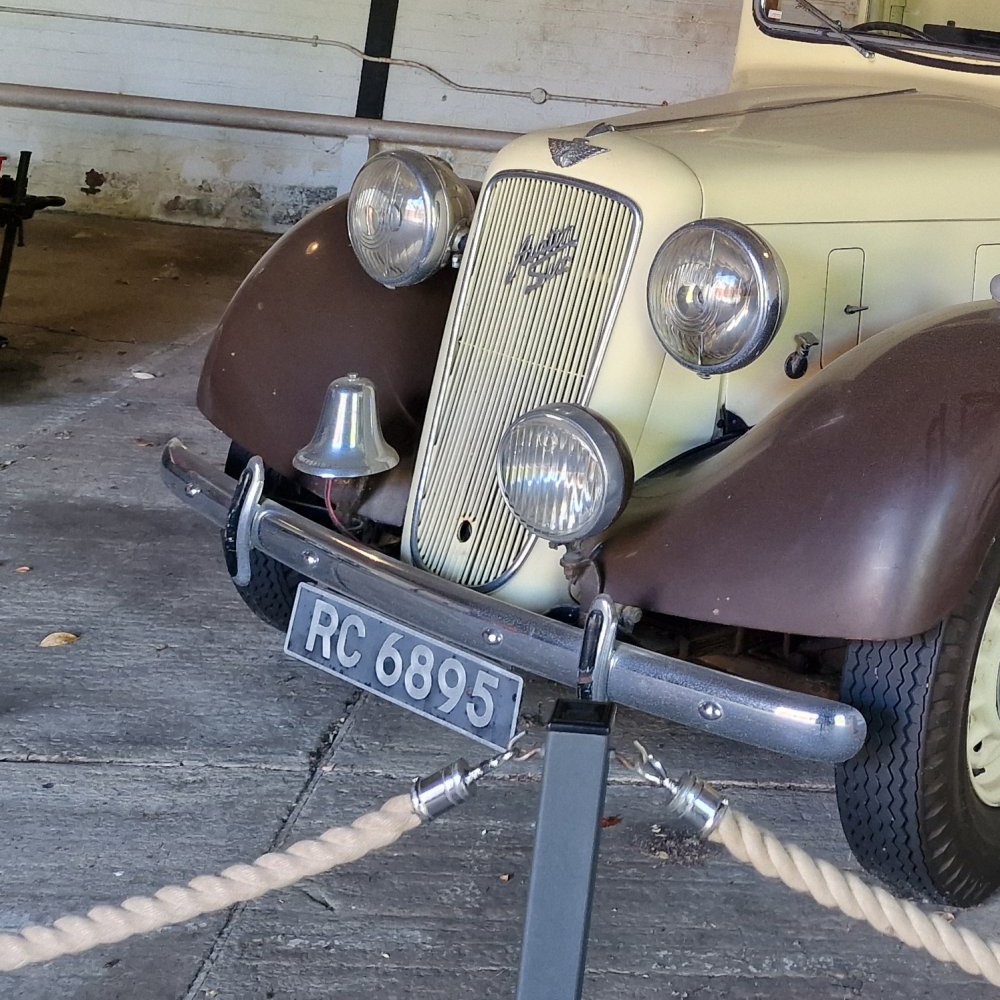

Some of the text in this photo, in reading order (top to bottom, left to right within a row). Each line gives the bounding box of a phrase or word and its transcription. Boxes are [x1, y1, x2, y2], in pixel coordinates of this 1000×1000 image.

[506, 225, 578, 285] Austin
[305, 599, 499, 728] RC 6895
